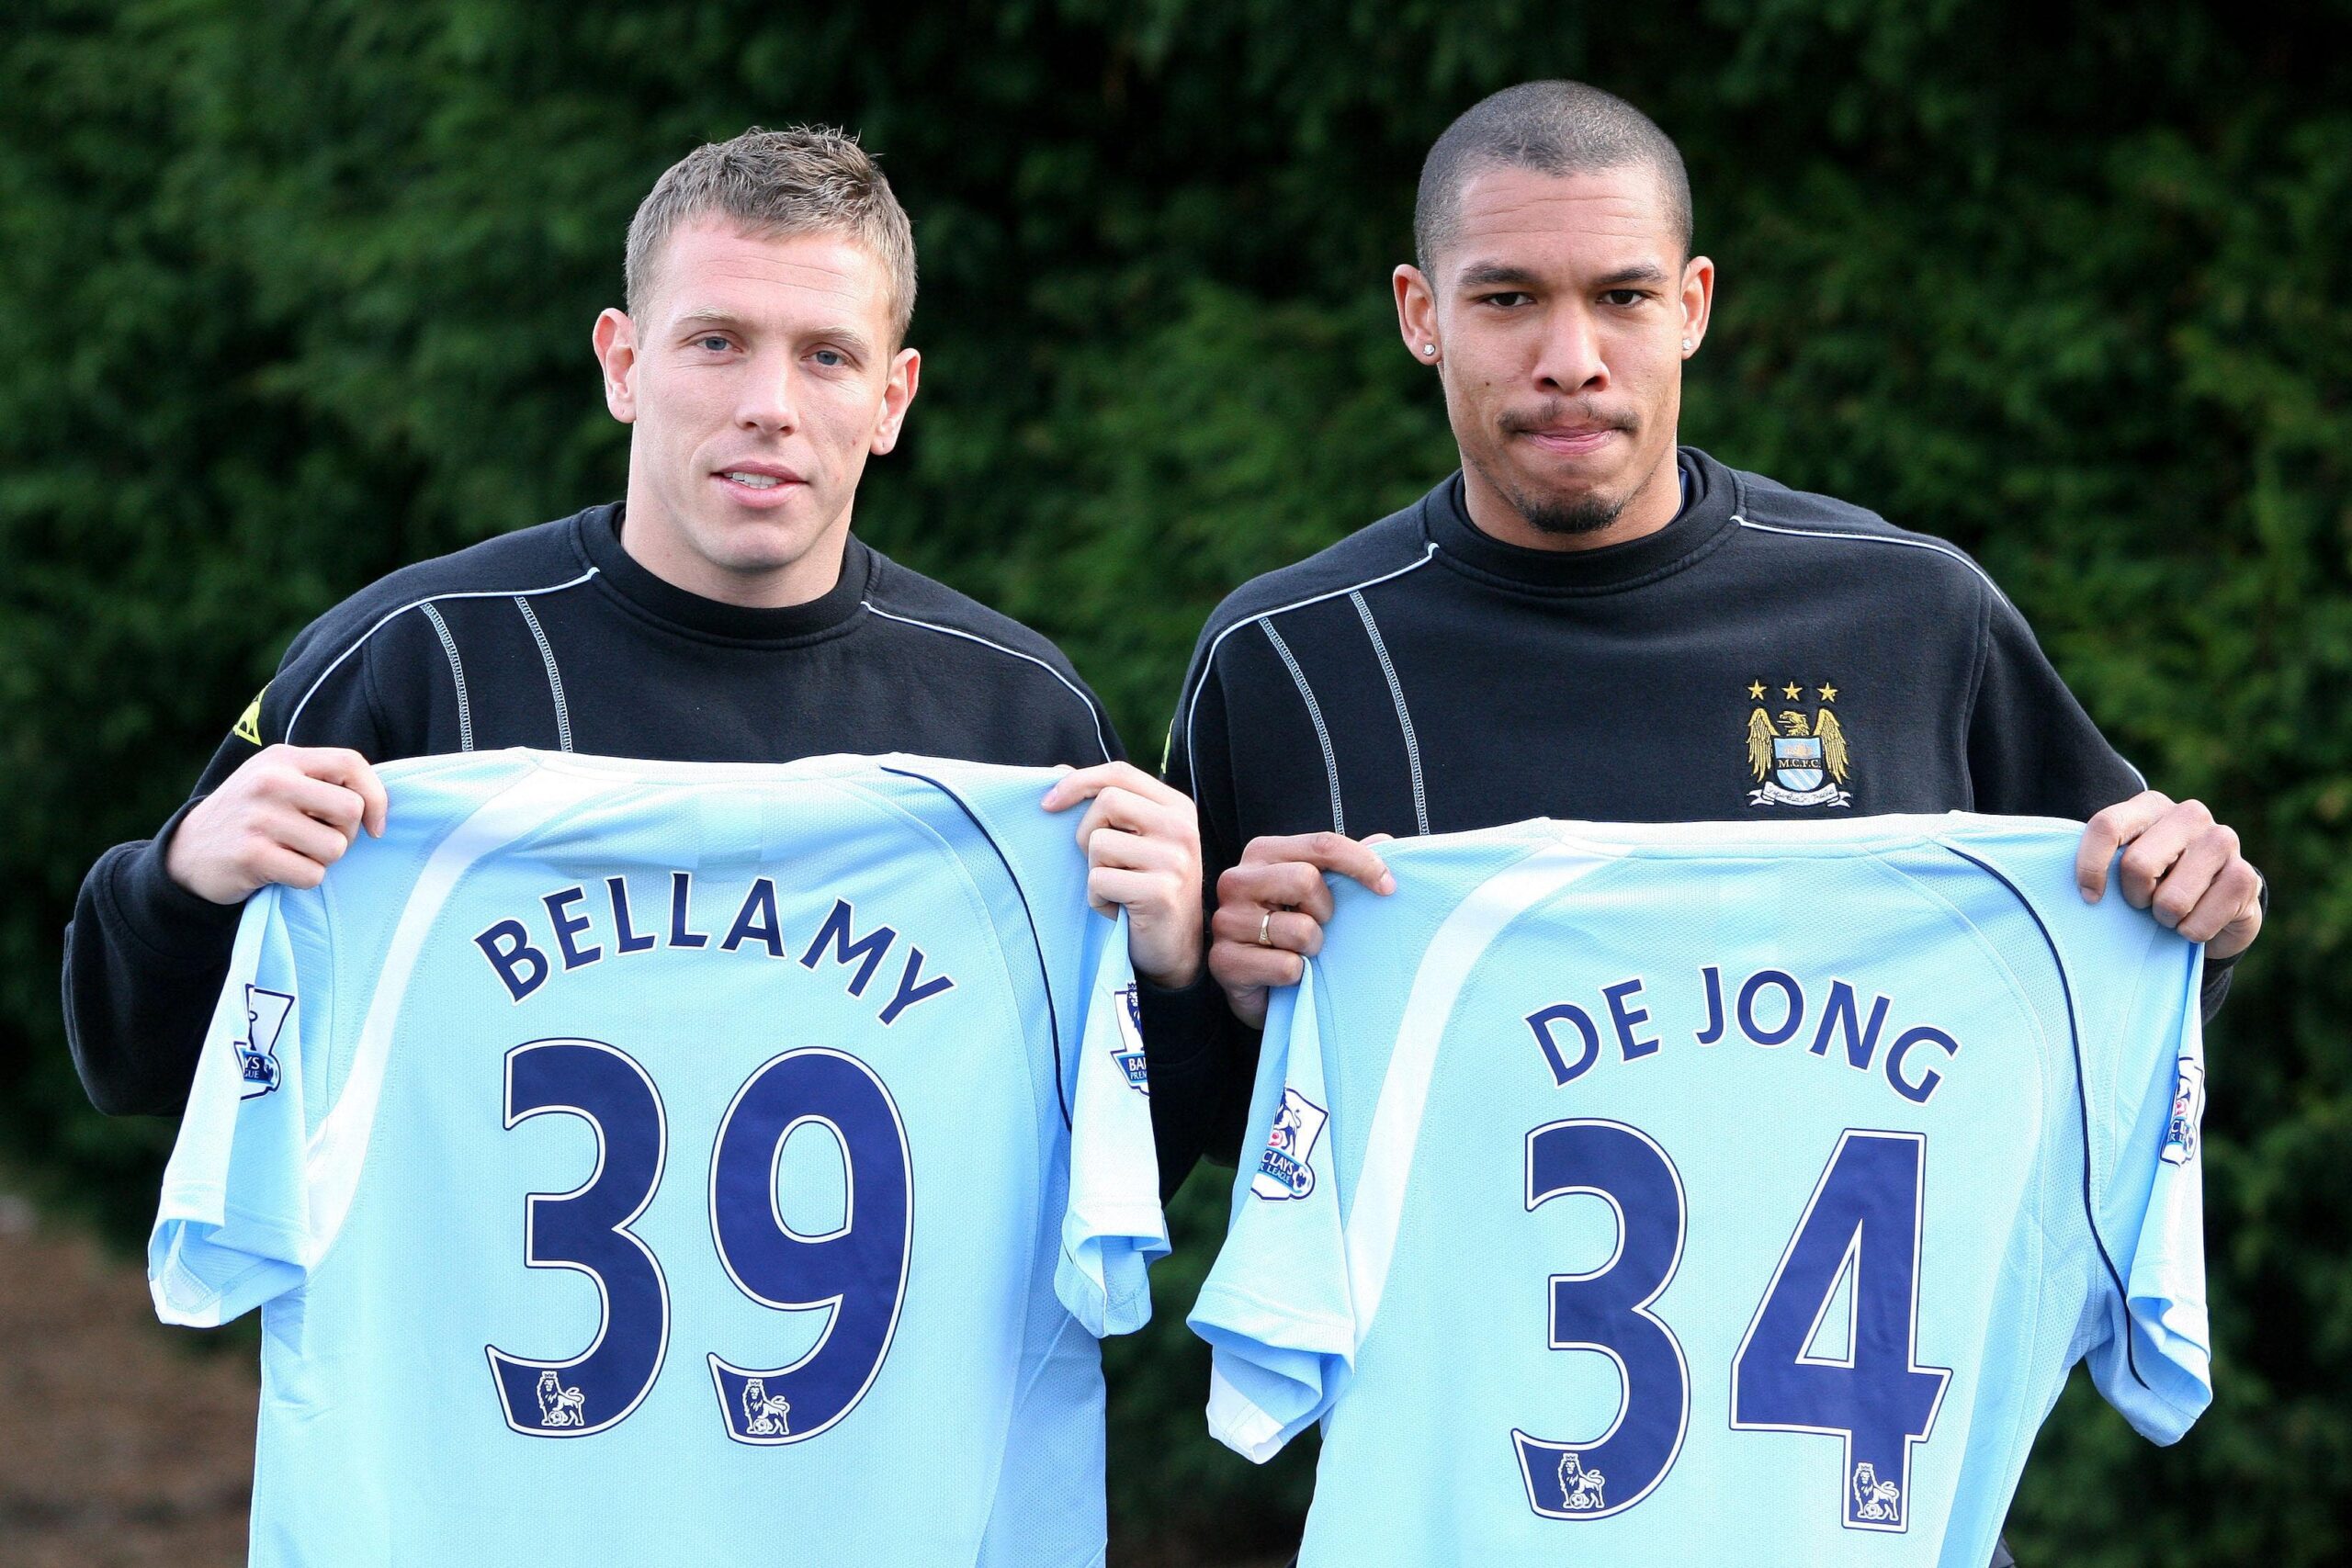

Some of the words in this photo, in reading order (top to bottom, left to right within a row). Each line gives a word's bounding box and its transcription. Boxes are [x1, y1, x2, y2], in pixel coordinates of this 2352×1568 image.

[474, 872, 956, 1027] BELLAMY
[1524, 975, 1661, 1089] DE
[1695, 964, 1960, 1107] JONG
[1261, 1149, 1295, 1177] CLAYS
[484, 1036, 915, 1447] 39
[1510, 1117, 1954, 1534] 34
